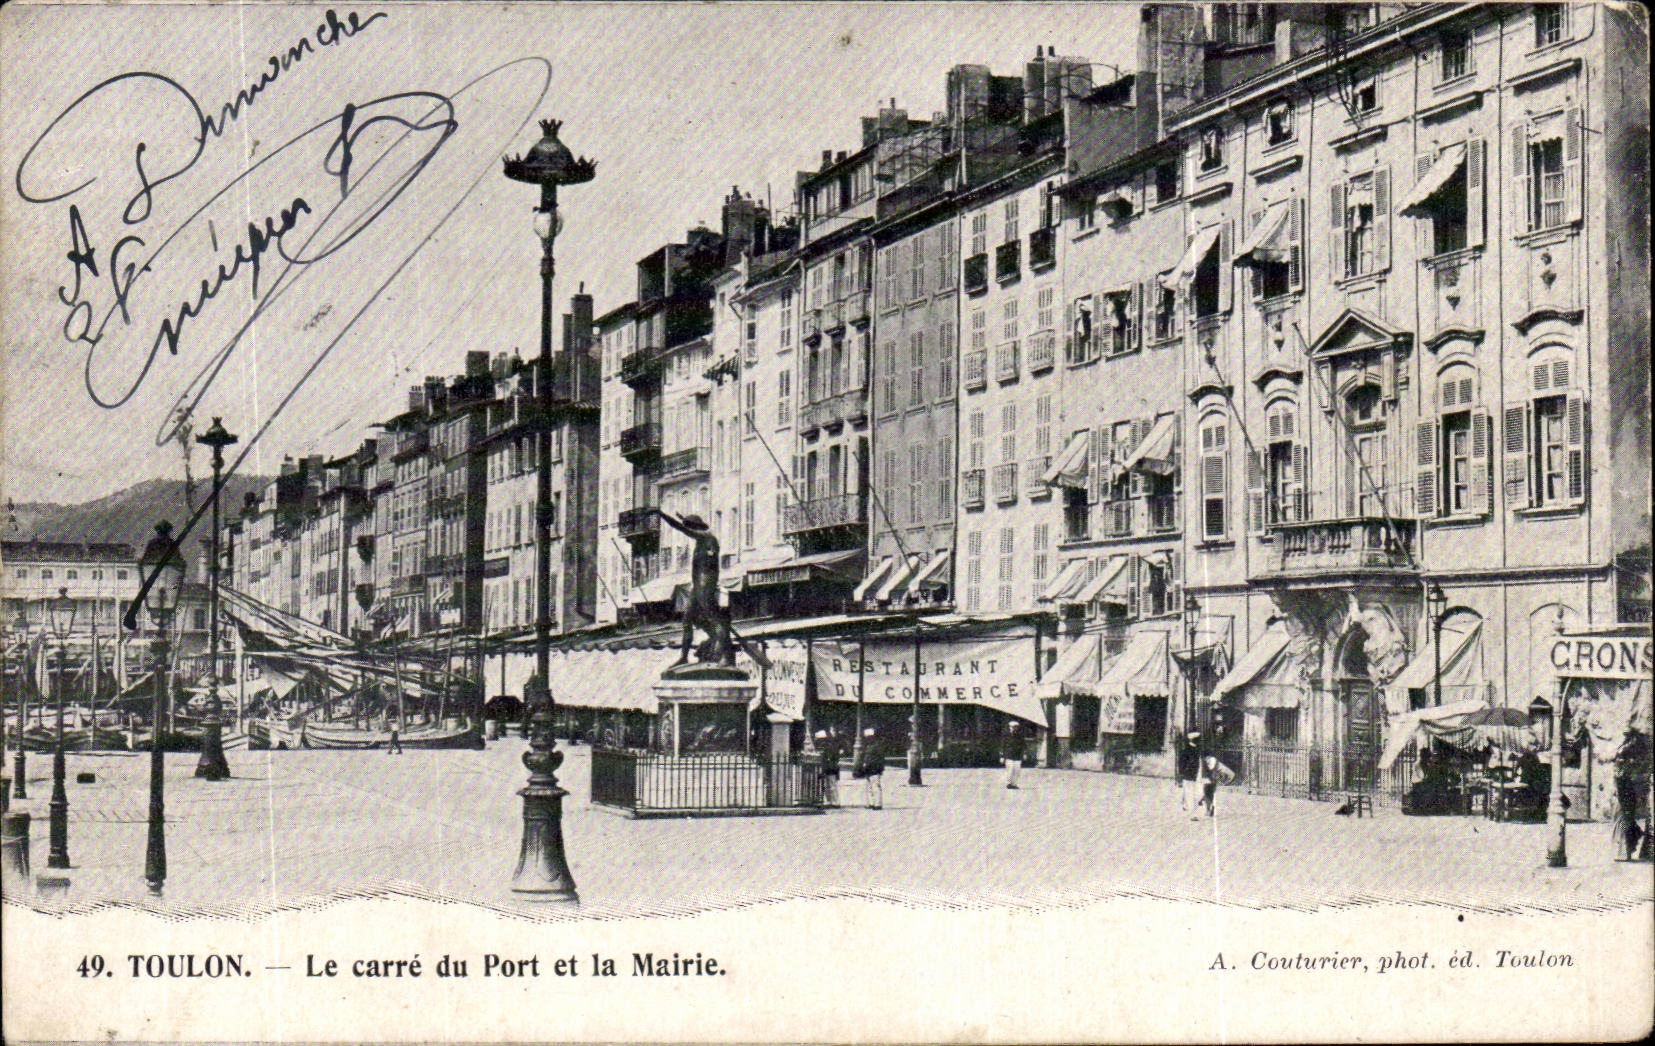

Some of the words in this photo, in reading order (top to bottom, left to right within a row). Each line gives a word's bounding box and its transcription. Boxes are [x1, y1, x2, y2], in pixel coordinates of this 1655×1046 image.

[833, 659, 998, 676] RESTAURANT
[835, 684, 861, 698] DU
[885, 683, 1018, 700] COMMERCE
